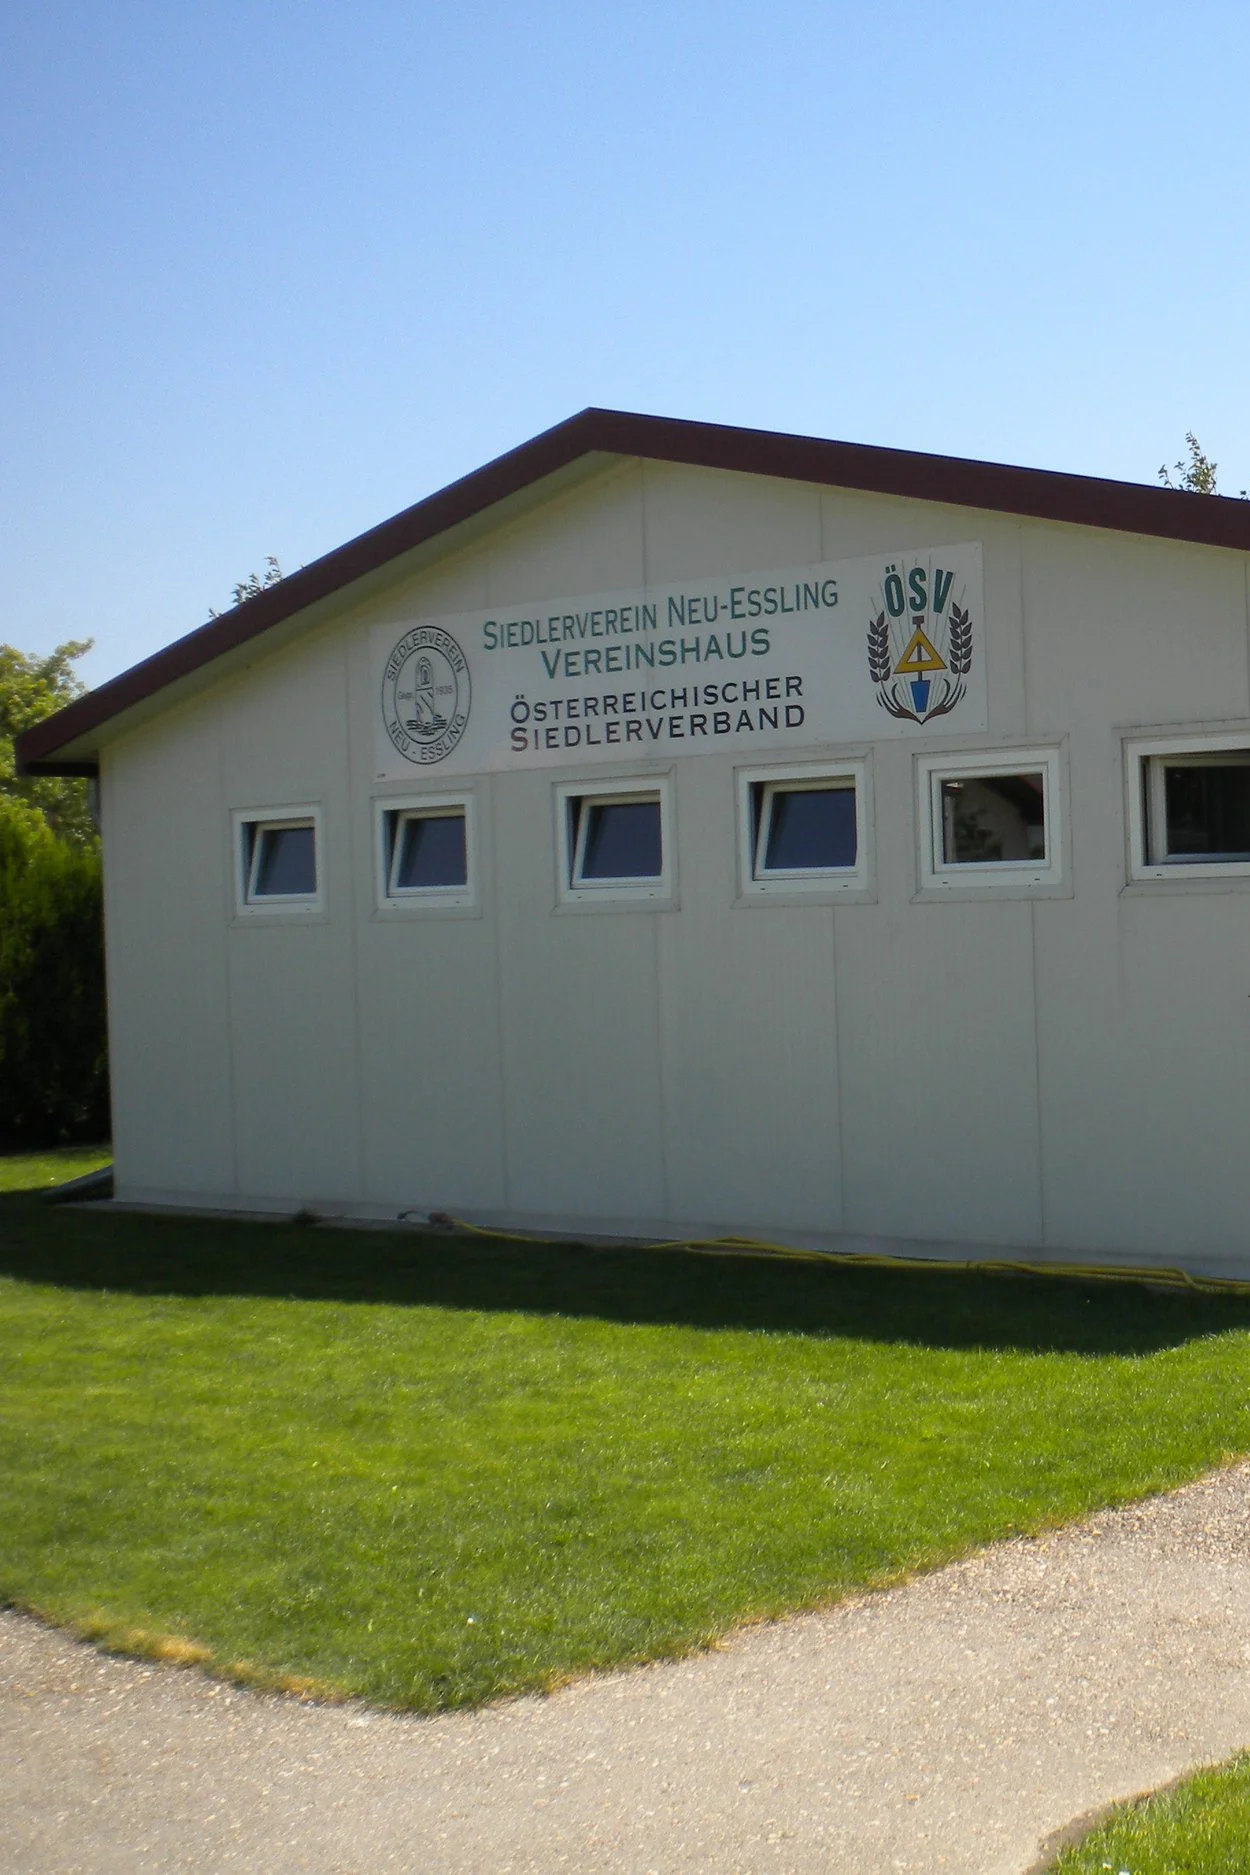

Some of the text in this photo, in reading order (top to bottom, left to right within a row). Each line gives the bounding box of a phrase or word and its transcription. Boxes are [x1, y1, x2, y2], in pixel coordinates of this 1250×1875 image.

[483, 579, 840, 651] SIEDLERVEREIN NEU-ESSLING
[884, 564, 954, 618] ÖSV
[387, 630, 465, 682] SIEDLERVEREIN
[541, 628, 772, 680] VEREINSHAUS
[510, 675, 804, 725] ÖSTERREICHISCHER
[420, 713, 466, 761] ESSLING
[509, 704, 806, 753] SIEDLERVERBAND
